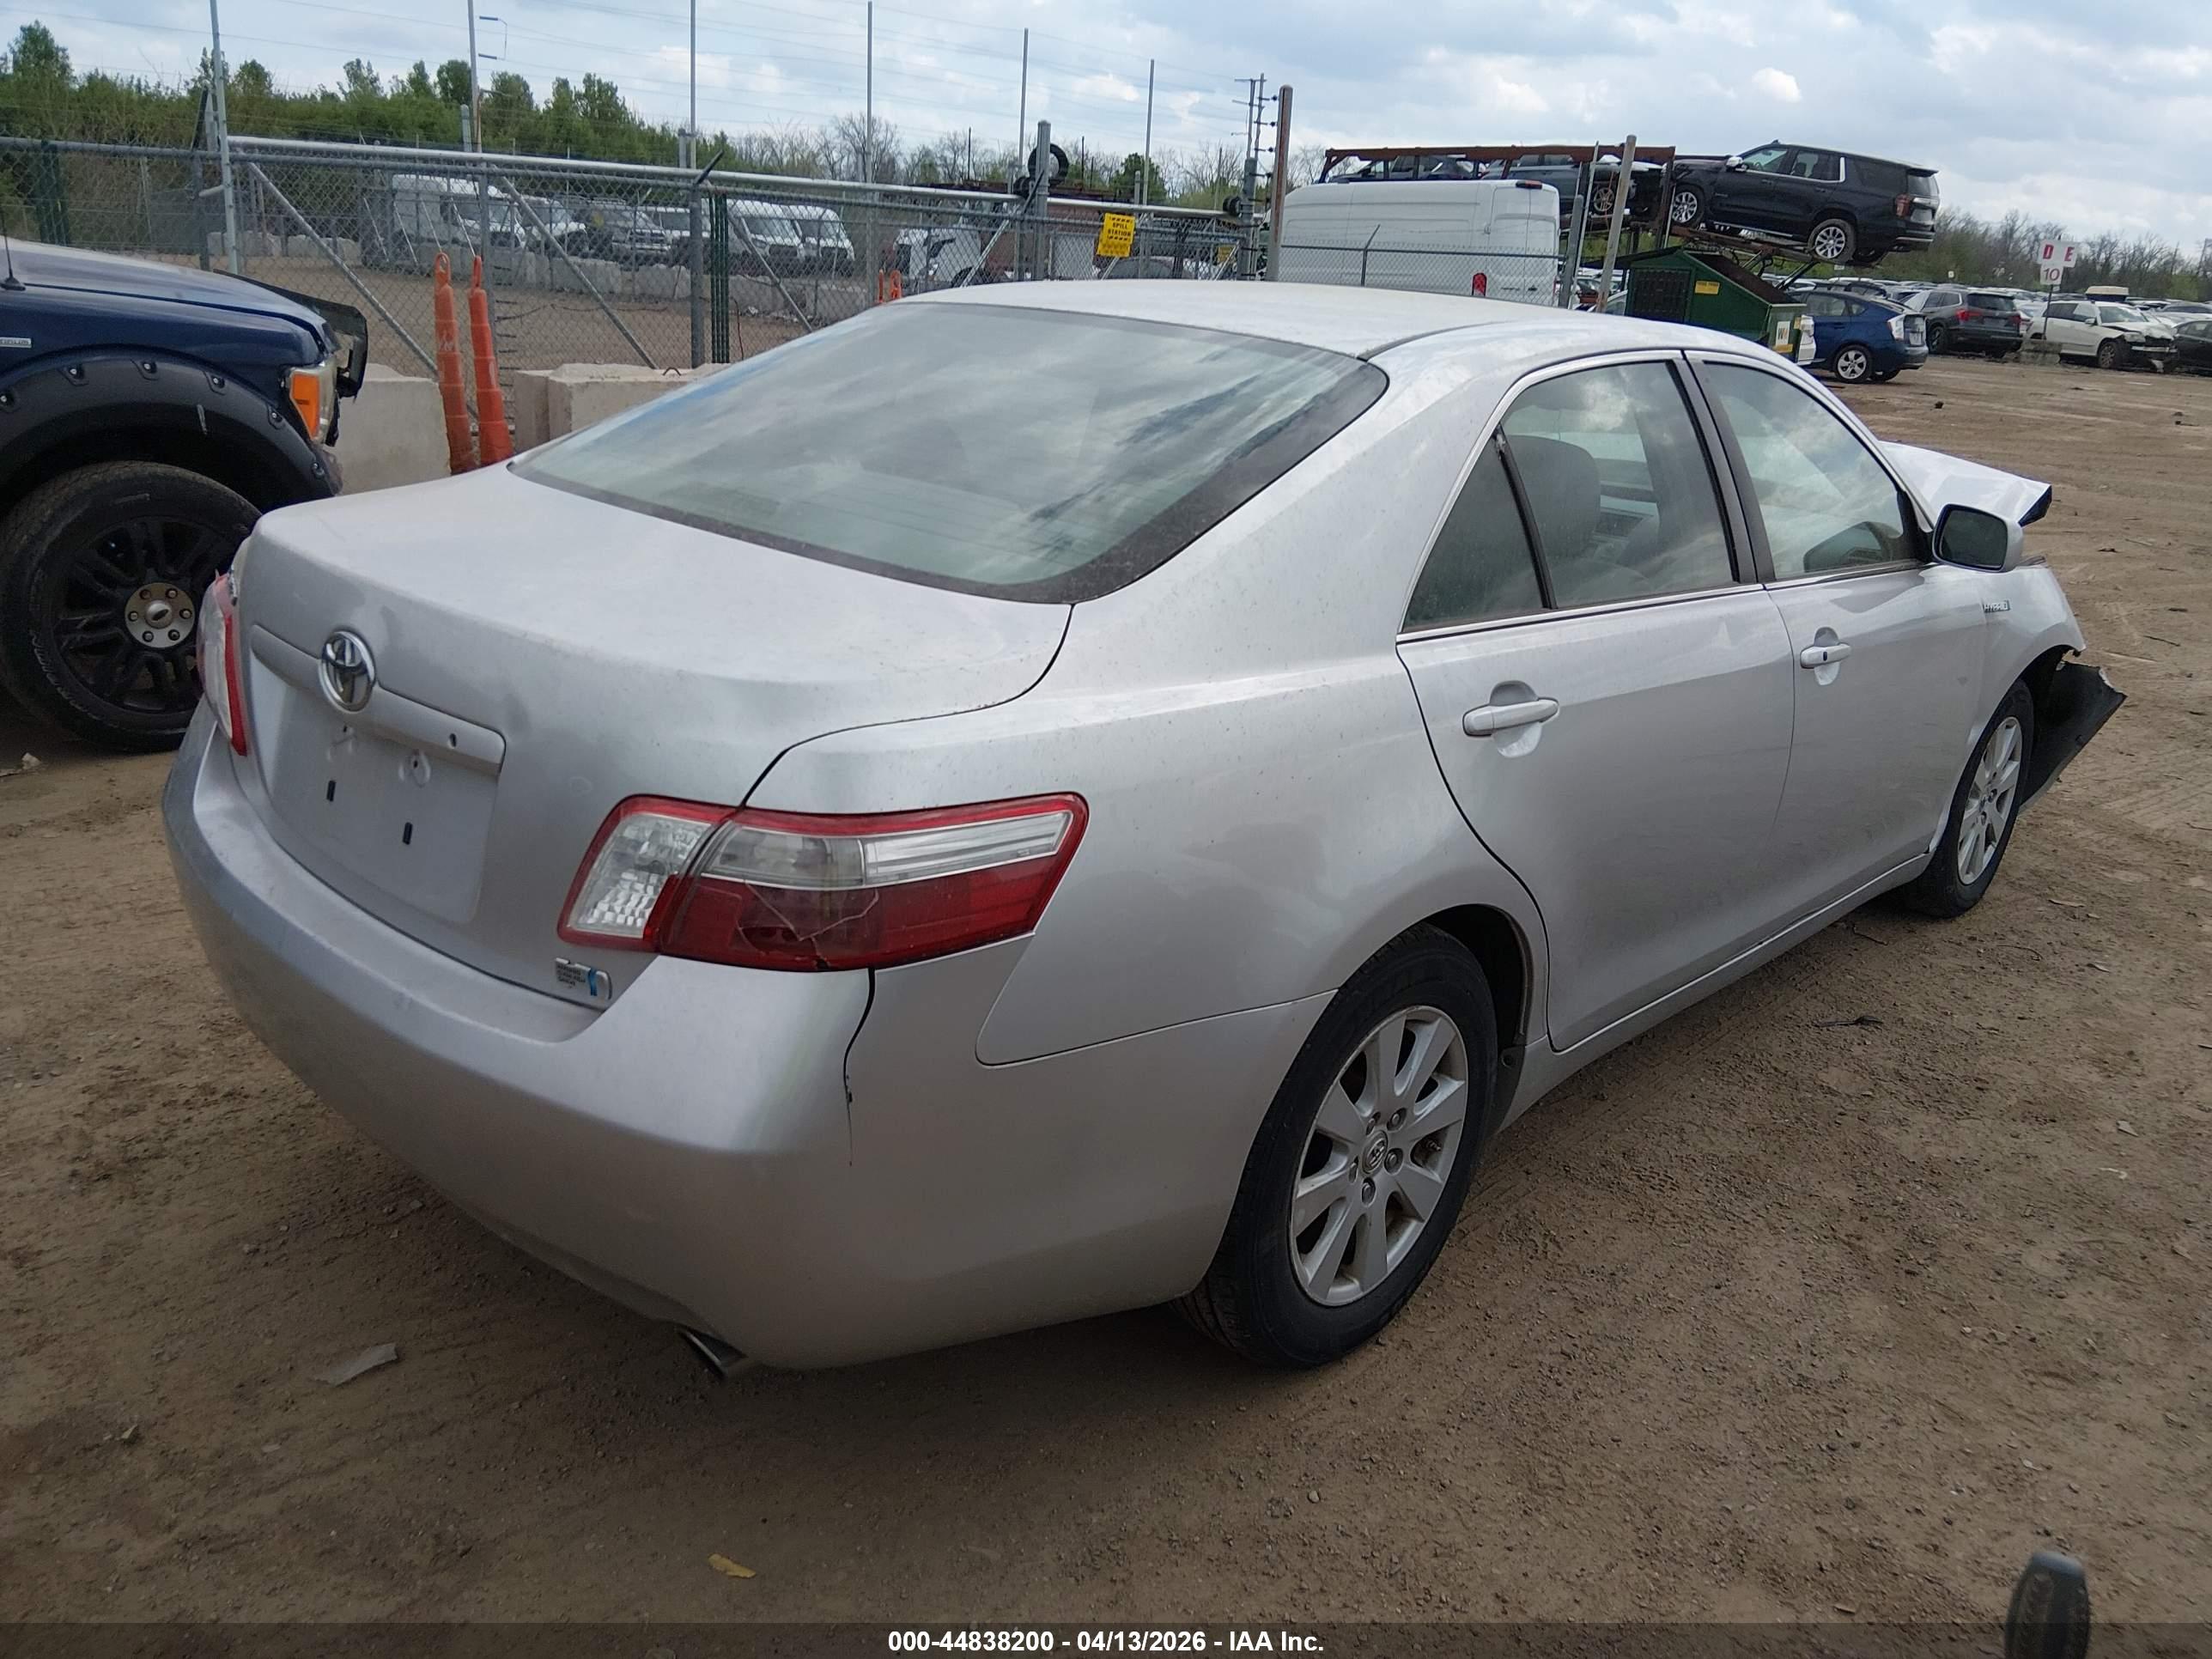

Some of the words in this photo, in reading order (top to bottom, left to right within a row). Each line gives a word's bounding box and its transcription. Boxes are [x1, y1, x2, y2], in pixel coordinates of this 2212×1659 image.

[2043, 244, 2054, 259] D
[2064, 246, 2075, 261] E
[2044, 268, 2060, 281] 10
